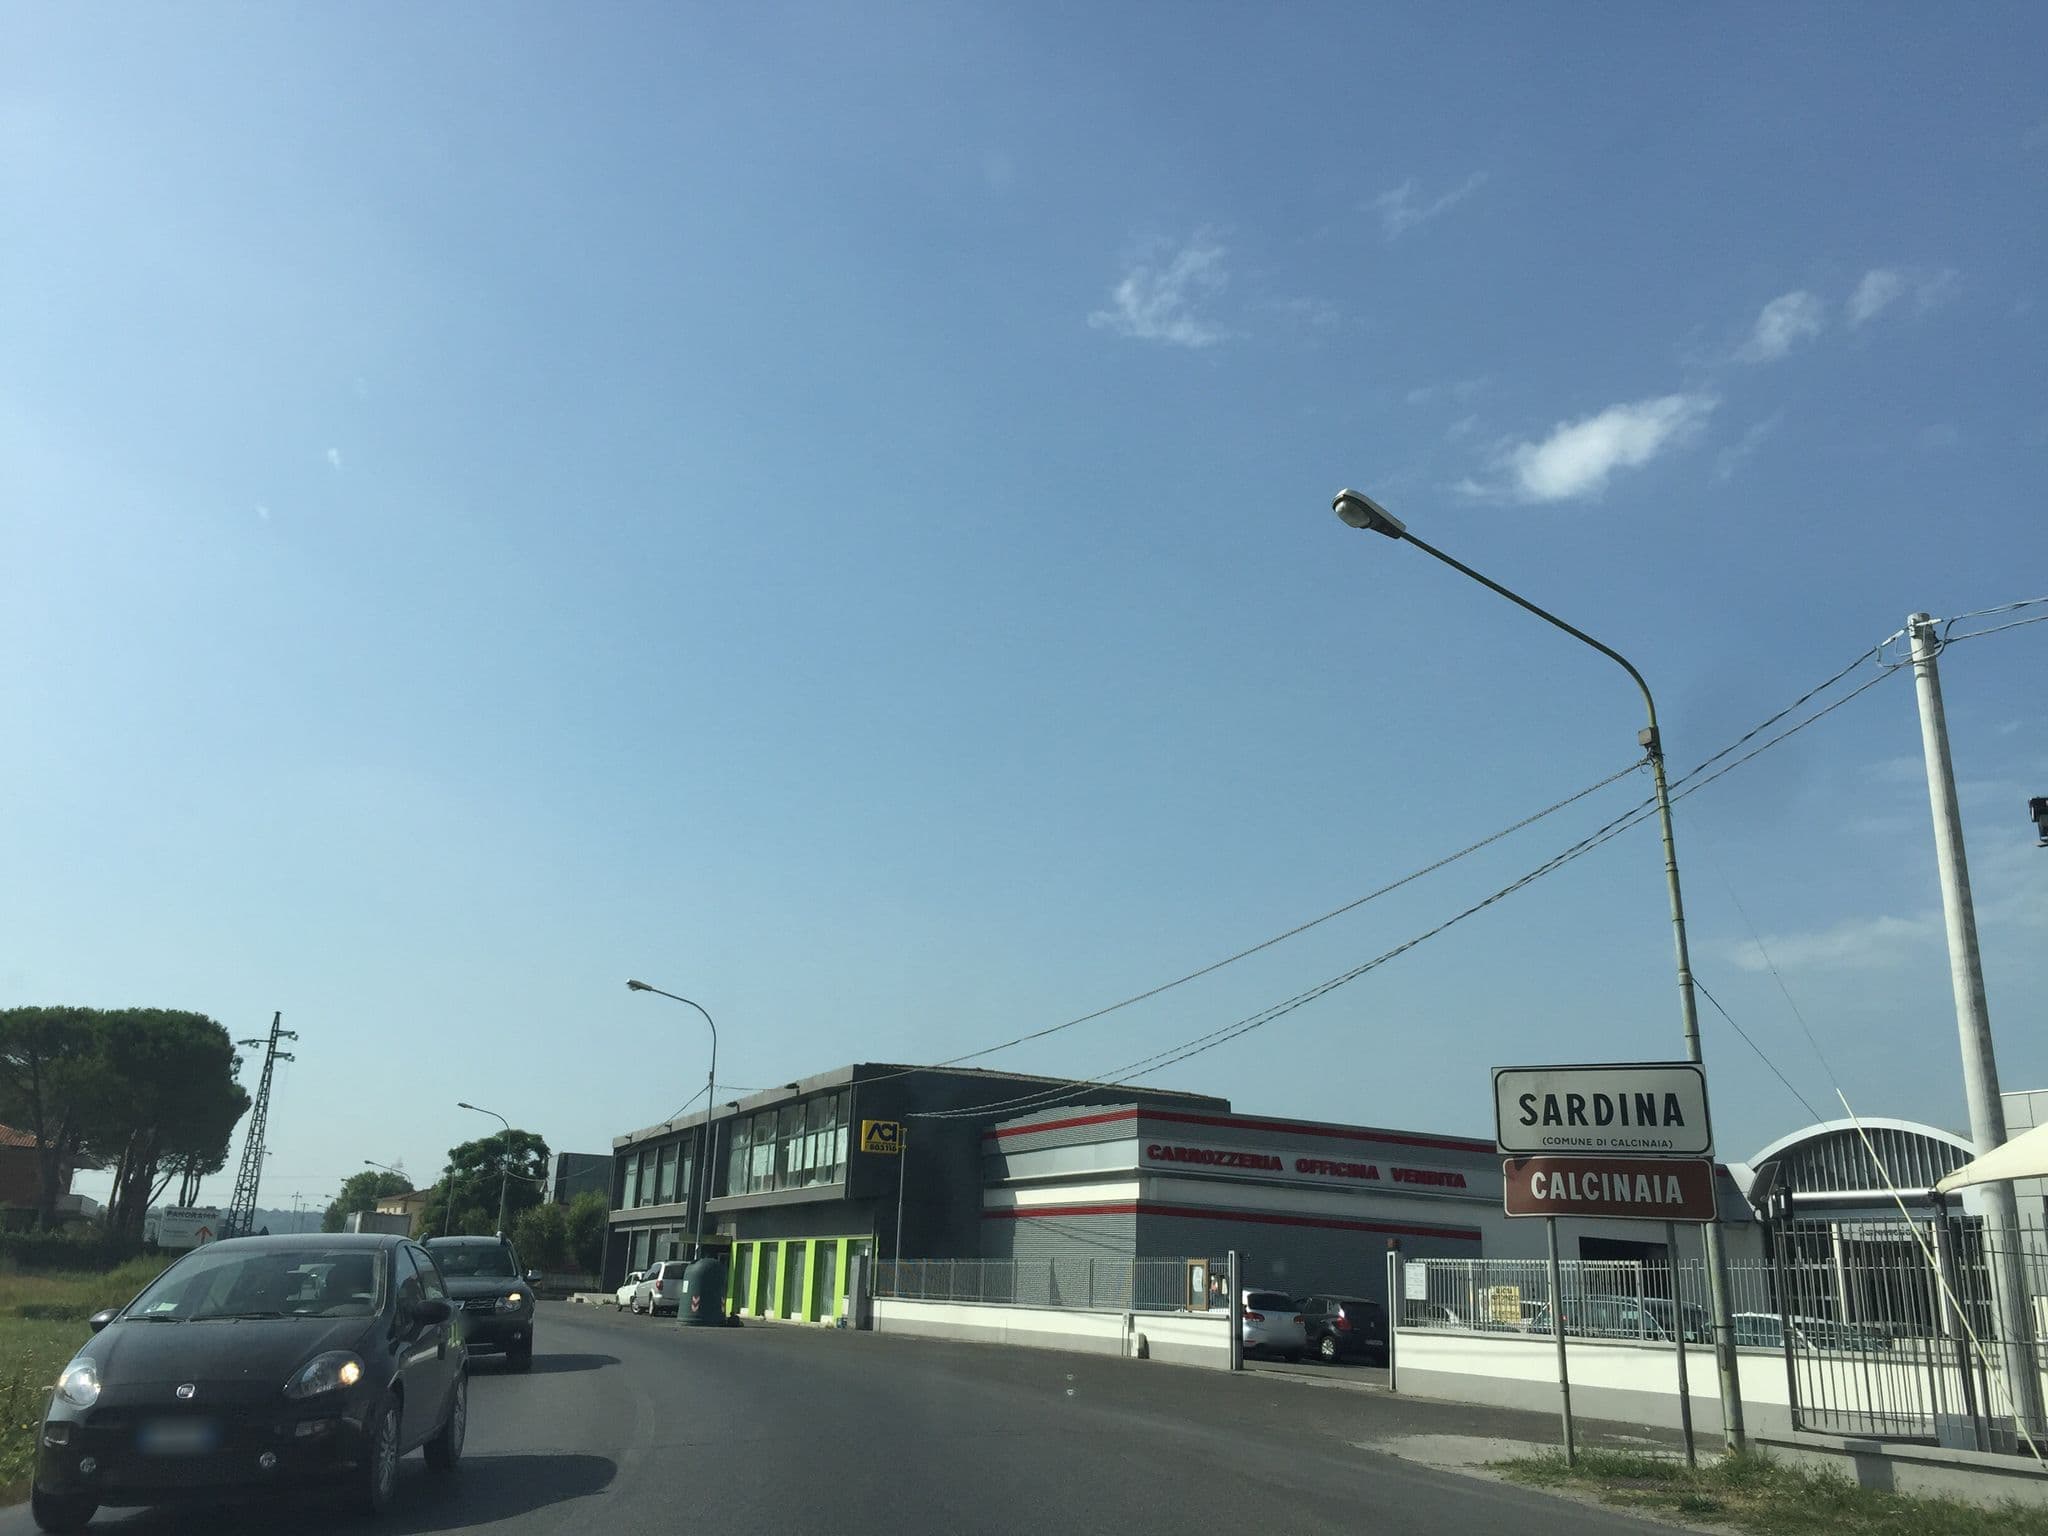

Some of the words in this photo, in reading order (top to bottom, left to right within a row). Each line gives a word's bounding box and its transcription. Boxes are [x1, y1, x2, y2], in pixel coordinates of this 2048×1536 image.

[1518, 1093, 1685, 1127] SARDINA
[867, 1122, 898, 1142] ACI
[1542, 1136, 1593, 1147] (COMUNE
[1596, 1138, 1607, 1147] DI
[1610, 1138, 1673, 1149] CALCINAIA)
[1146, 1144, 1283, 1171] CARROZZERIA
[1295, 1158, 1381, 1180] OFFICINA
[1390, 1167, 1467, 1188] VENDITA
[1530, 1171, 1684, 1204] CALCINAIA
